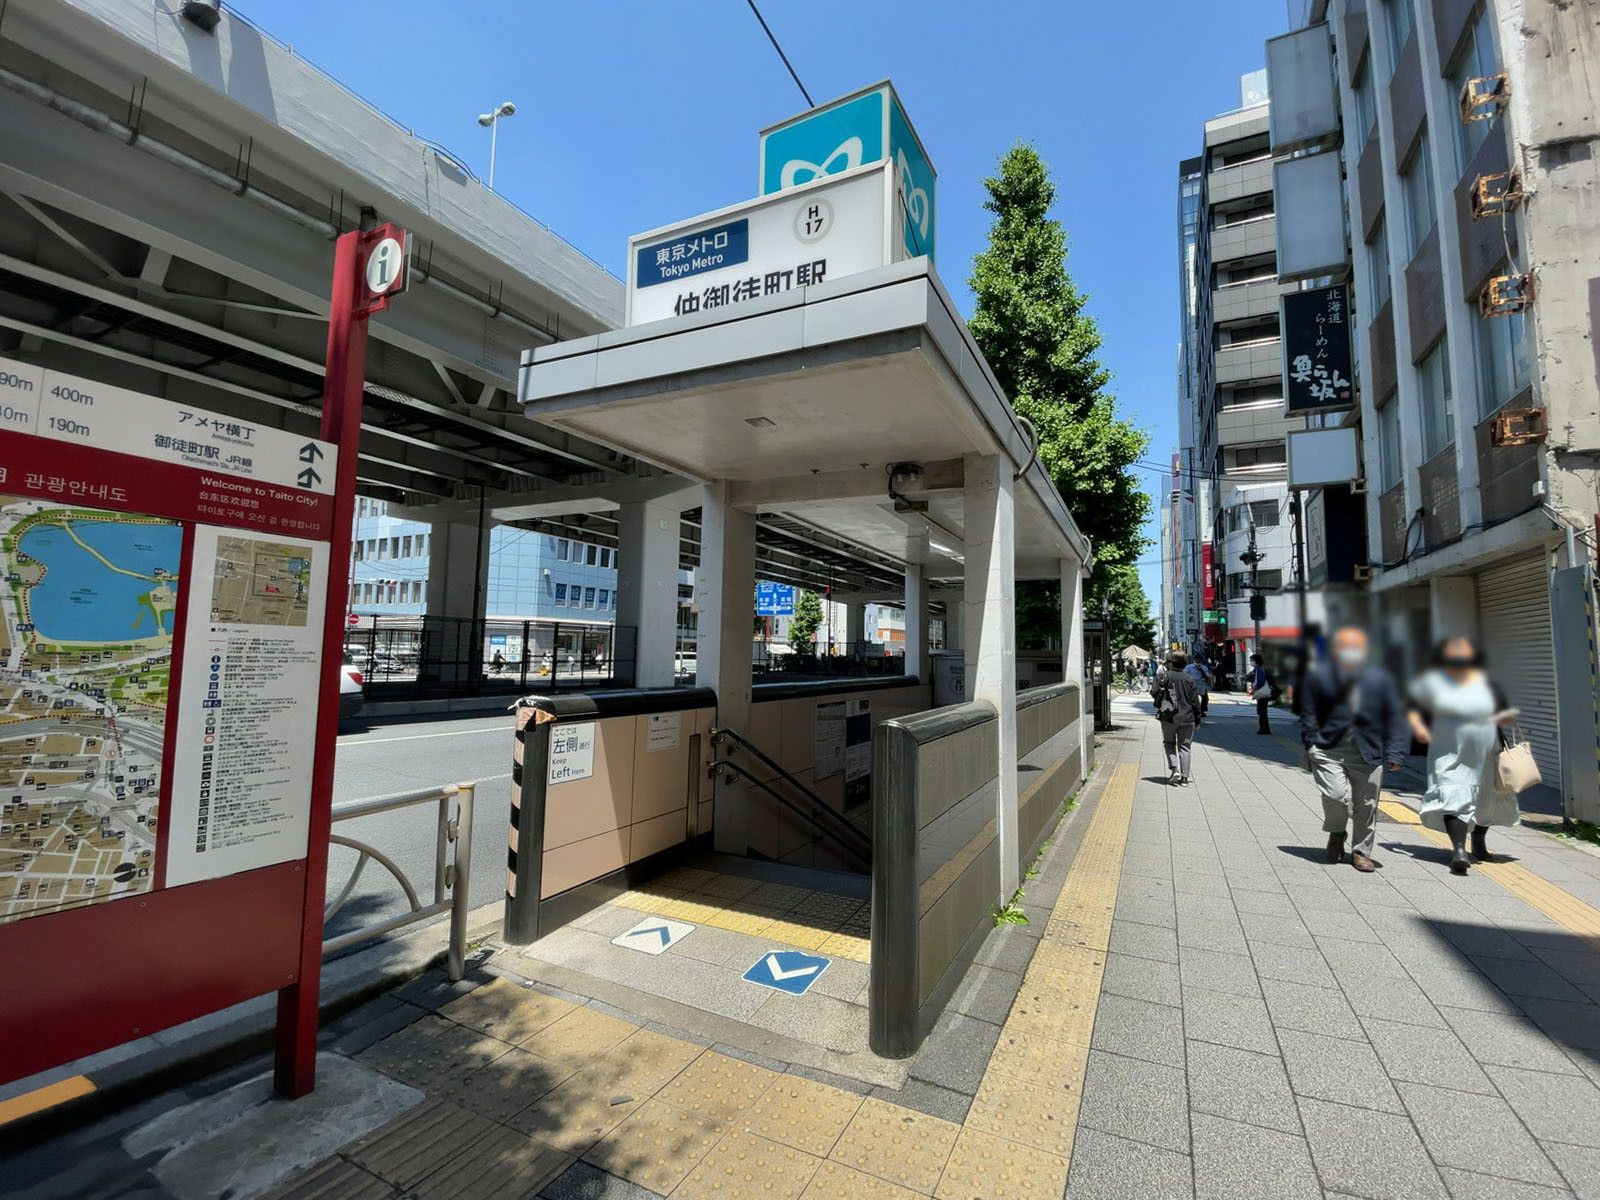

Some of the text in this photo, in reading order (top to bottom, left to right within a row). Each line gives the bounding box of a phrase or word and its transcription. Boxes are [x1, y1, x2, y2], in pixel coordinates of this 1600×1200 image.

[808, 205, 819, 219] H
[805, 218, 824, 235] 17
[656, 231, 728, 265] 東京メトロ
[660, 253, 724, 279] Tokyo Metro
[1326, 289, 1342, 323] 北海道
[1315, 313, 1328, 359] らーめん
[51, 385, 94, 407] 400m
[48, 416, 90, 437] 190m
[178, 410, 256, 440] アメヤ横丁
[154, 433, 220, 461] 御徒町駅
[24, 473, 128, 501] 관광안내도
[201, 476, 318, 507] Welcome to Taito City!
[553, 727, 576, 736] ここでは
[552, 758, 567, 766] Keep
[552, 766, 570, 779] Left
